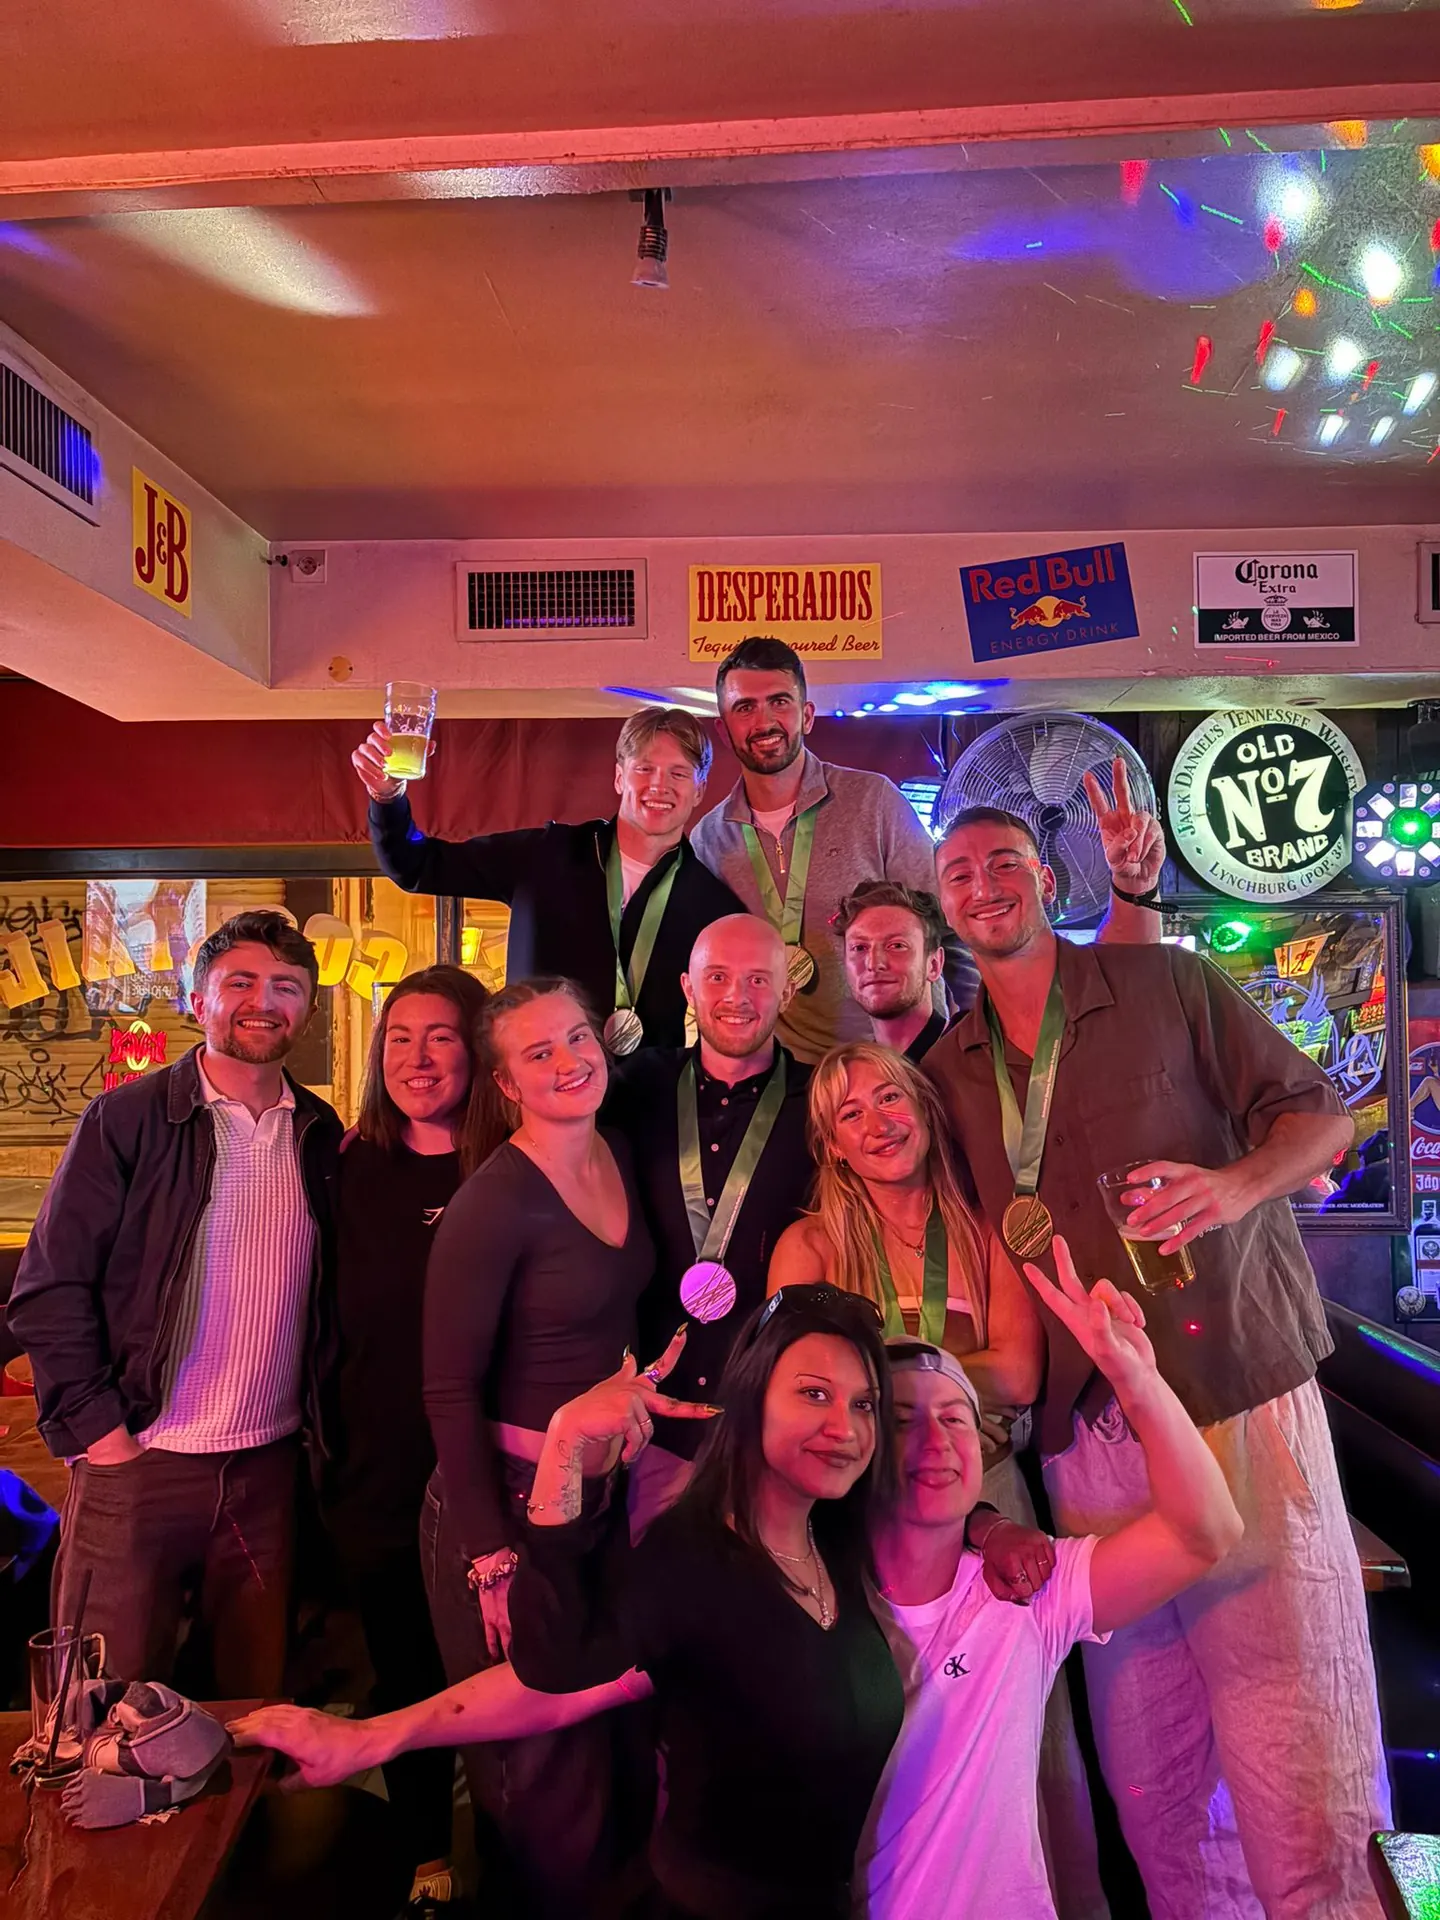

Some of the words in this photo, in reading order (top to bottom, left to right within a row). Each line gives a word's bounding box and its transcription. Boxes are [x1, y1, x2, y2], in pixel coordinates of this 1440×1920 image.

[135, 482, 189, 603] J&B
[968, 560, 1041, 604] Red
[1046, 547, 1116, 591] Bull
[1235, 559, 1319, 586] Corona
[1259, 581, 1297, 593] Extra
[696, 570, 872, 622] DESPERADOS
[693, 636, 746, 658] Tequi
[841, 634, 880, 651] Beer
[990, 631, 1060, 654] ENERGY
[1066, 622, 1119, 641] DRINK
[1214, 633, 1257, 641] IMPORTED
[1258, 633, 1281, 641] BEER
[1282, 633, 1306, 641] FROM
[1307, 632, 1340, 641] MEXICO
[1223, 708, 1311, 729] TENNESSEE
[1174, 724, 1225, 788] DANIEL'S
[1236, 734, 1296, 764] OLD
[1318, 722, 1358, 794] WHISKEY
[1177, 793, 1196, 837] JACK
[1246, 834, 1329, 870] BRAND
[1208, 861, 1297, 895] LYNCHBURG
[1301, 859, 1335, 888] (POP.
